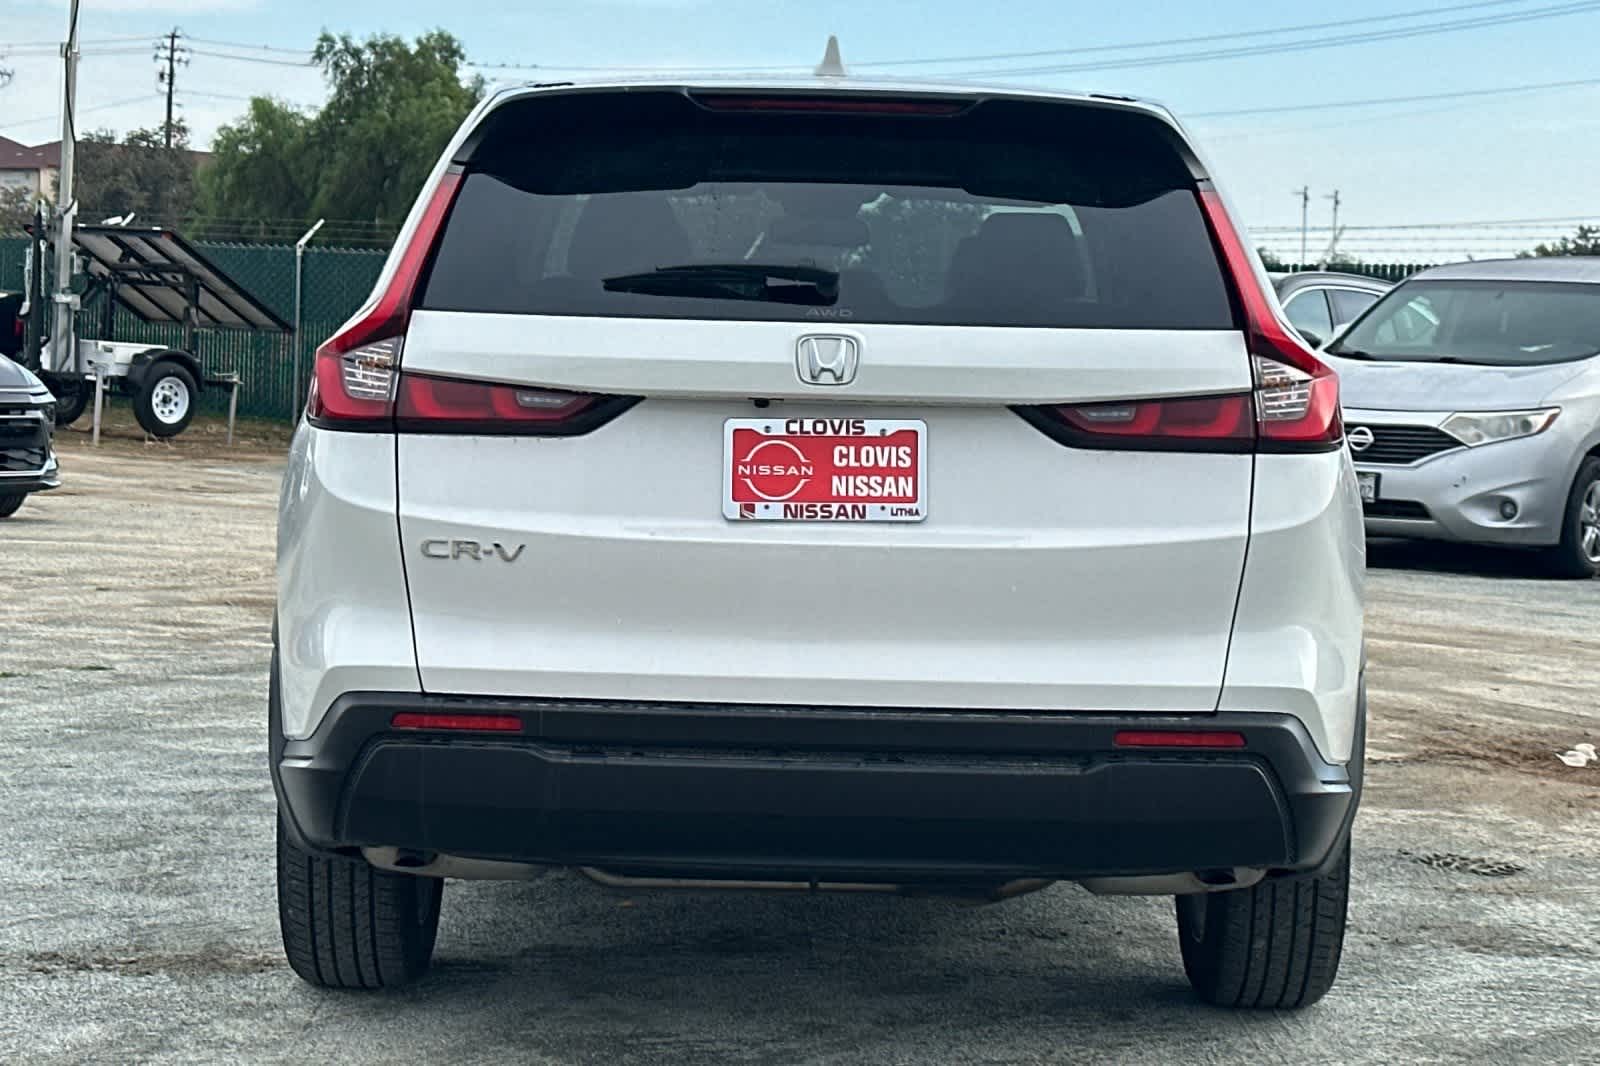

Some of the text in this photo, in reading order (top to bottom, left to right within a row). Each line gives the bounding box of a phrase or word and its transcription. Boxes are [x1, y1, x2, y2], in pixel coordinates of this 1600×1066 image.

[785, 419, 866, 436] CLOVIS
[833, 445, 912, 468] CLOVIS
[738, 465, 814, 475] NISSAN
[831, 475, 913, 497] NISSAN
[783, 503, 867, 520] NISSAN
[421, 539, 525, 562] CR-V
